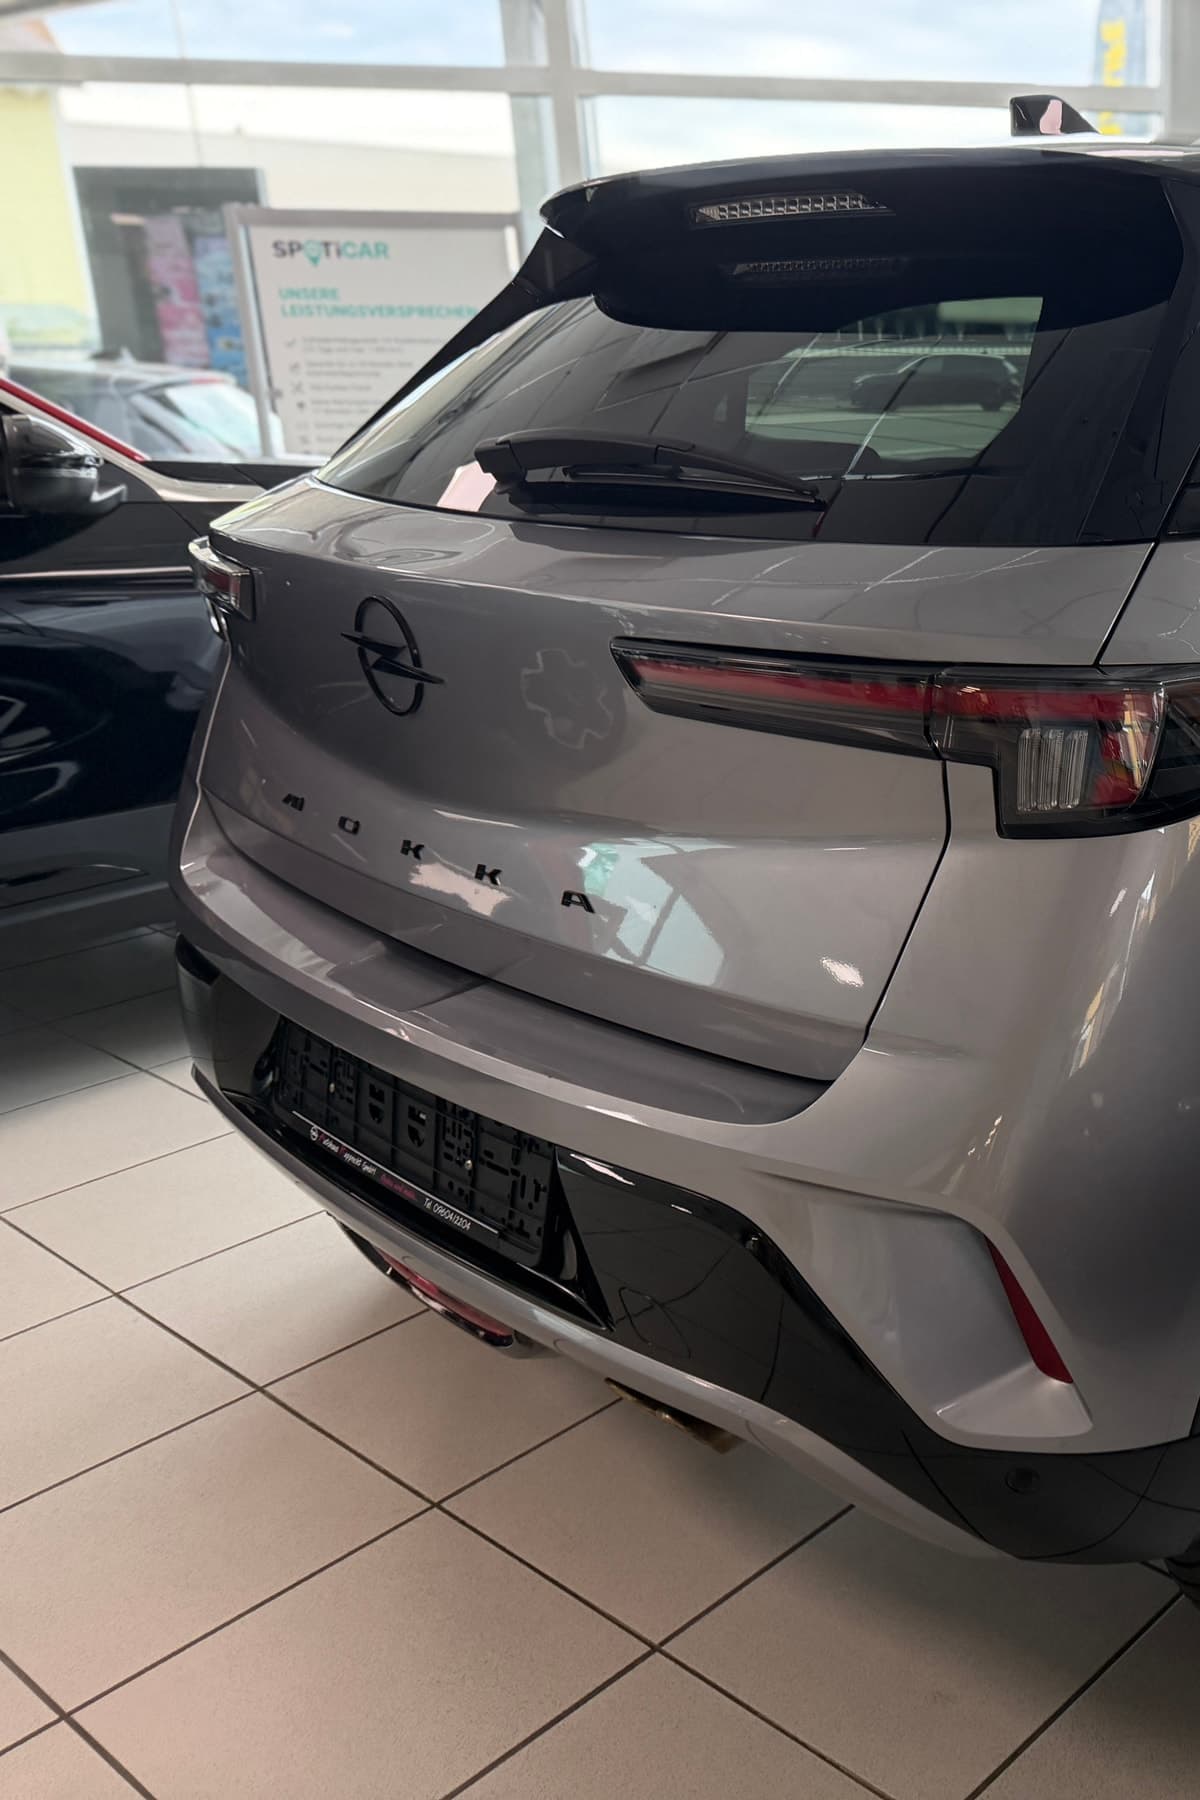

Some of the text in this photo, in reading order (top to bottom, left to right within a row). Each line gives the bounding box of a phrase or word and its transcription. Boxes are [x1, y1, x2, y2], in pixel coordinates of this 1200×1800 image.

[278, 287, 340, 301] UNSERE
[281, 304, 478, 319] LEISTUNGSVERSPRECHEN
[281, 793, 596, 914] MOKKA
